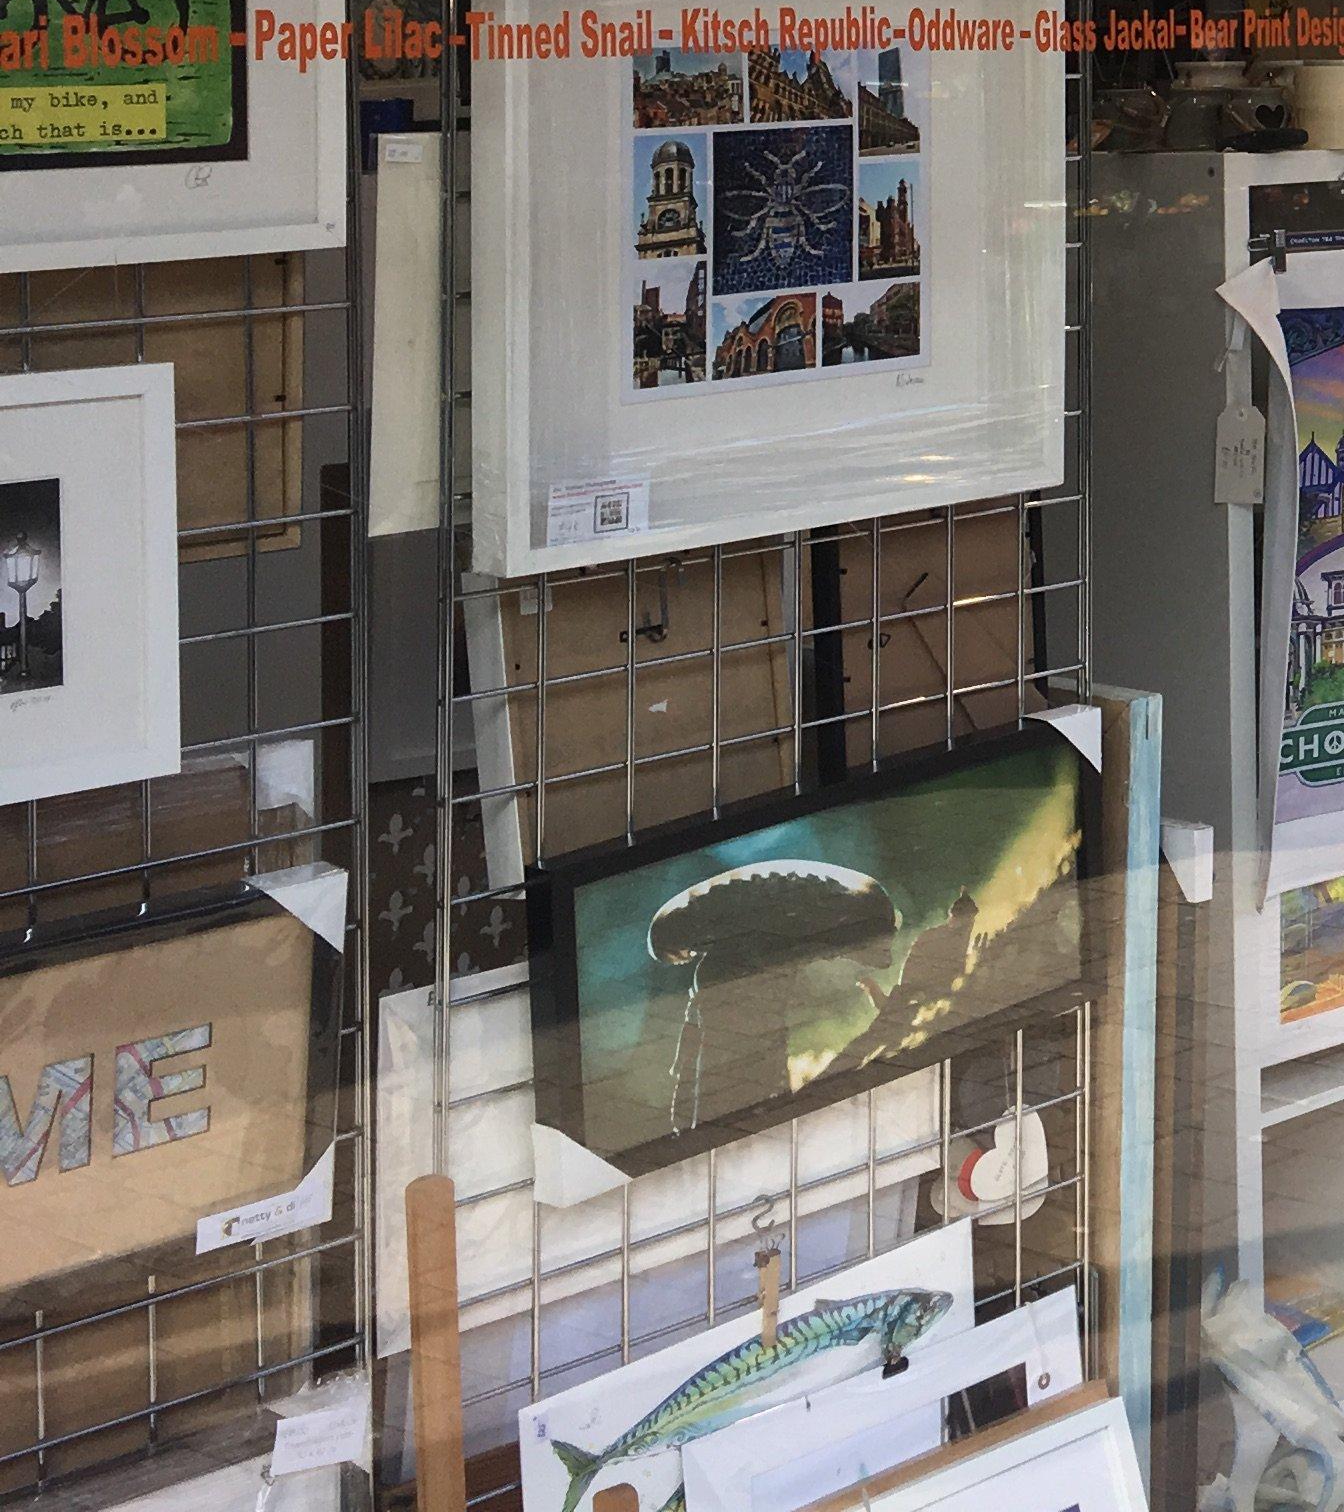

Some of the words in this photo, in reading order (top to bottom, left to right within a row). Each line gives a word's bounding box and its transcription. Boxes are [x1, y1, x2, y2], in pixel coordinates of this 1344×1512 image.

[0, 15, 48, 72] ari
[62, 13, 219, 69] Blossom
[254, 9, 353, 73] Paper
[364, 8, 442, 60] Lilac
[466, 10, 570, 61] Tinned
[581, 9, 652, 58] Snail
[682, 8, 770, 54] Kitsch
[1034, 9, 1096, 53] Glass
[1244, 9, 1290, 49] Print
[10, 94, 35, 113] my
[48, 92, 108, 109] bike,
[122, 90, 158, 106] and
[0, 124, 23, 140] ch
[37, 123, 86, 138] that
[0, 1022, 211, 1186] ME
[242, 1210, 271, 1226] netty
[286, 1201, 296, 1211] di
